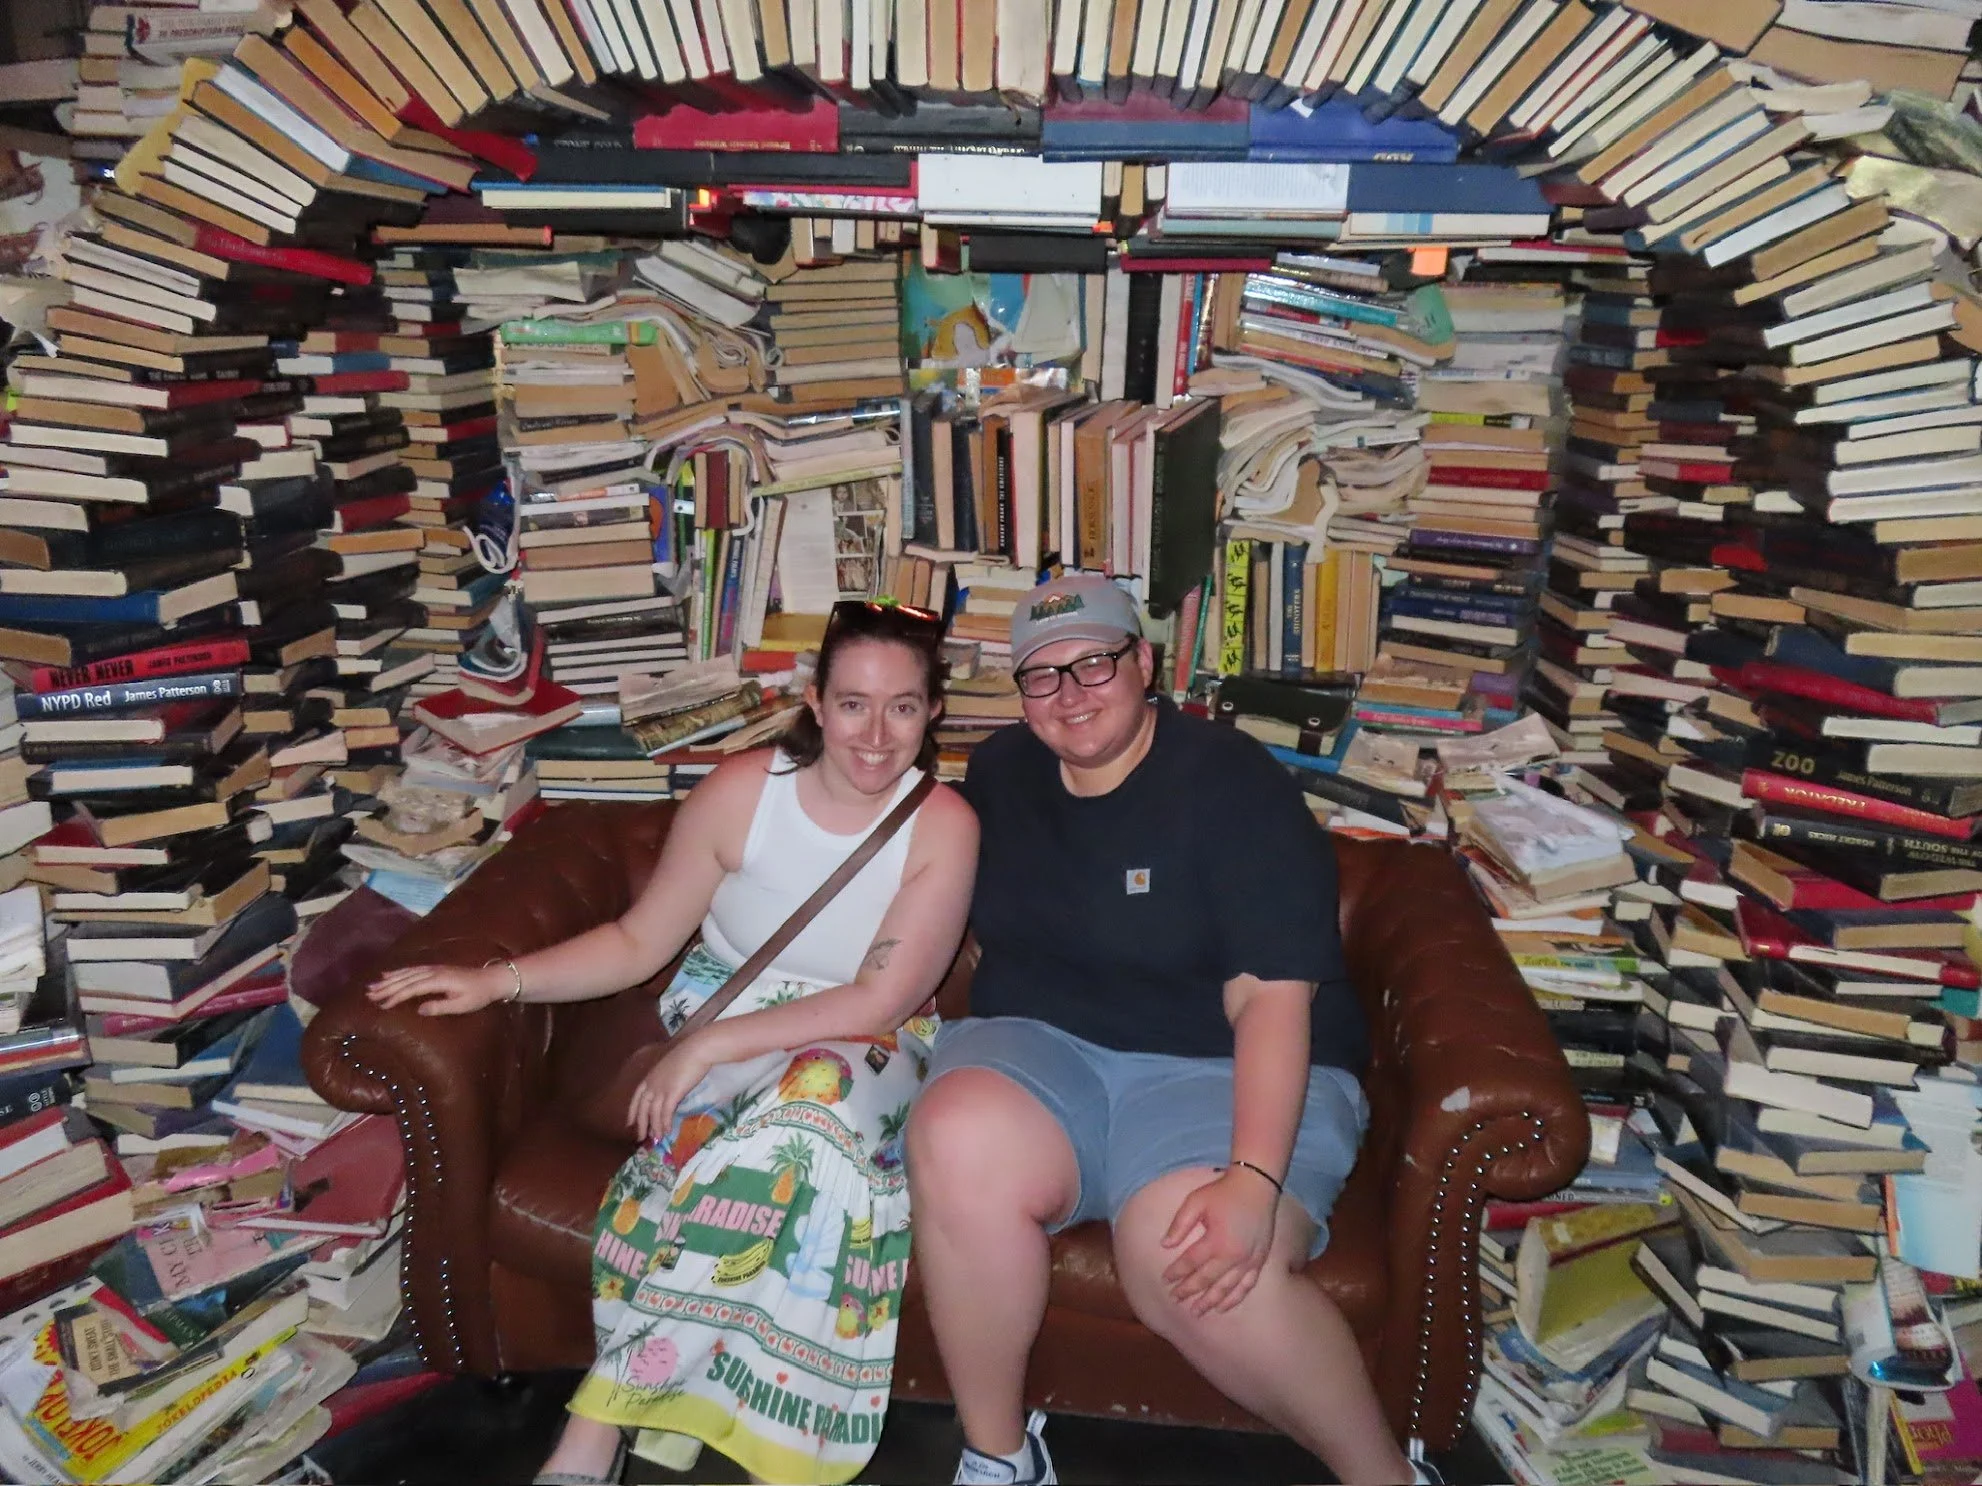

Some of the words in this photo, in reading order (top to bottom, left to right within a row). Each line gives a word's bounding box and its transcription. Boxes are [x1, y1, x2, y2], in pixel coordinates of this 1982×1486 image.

[49, 667, 89, 689] NEVER
[94, 659, 134, 680] NEVER
[41, 693, 82, 713] NYPD
[86, 690, 112, 708] Red
[125, 688, 158, 704] James
[158, 684, 207, 700] Patterson
[1771, 750, 1816, 775] ZOO
[1807, 831, 1837, 843] HICKS
[1903, 838, 1948, 854] SOUTH
[595, 1228, 648, 1281] HINE
[694, 1195, 787, 1240] RADISE
[168, 1261, 190, 1288] MY
[83, 1326, 97, 1350] SWEAT
[104, 1339, 118, 1362] SMALL
[108, 1362, 120, 1376] THE
[156, 1369, 238, 1435] JOKELOPEDIA
